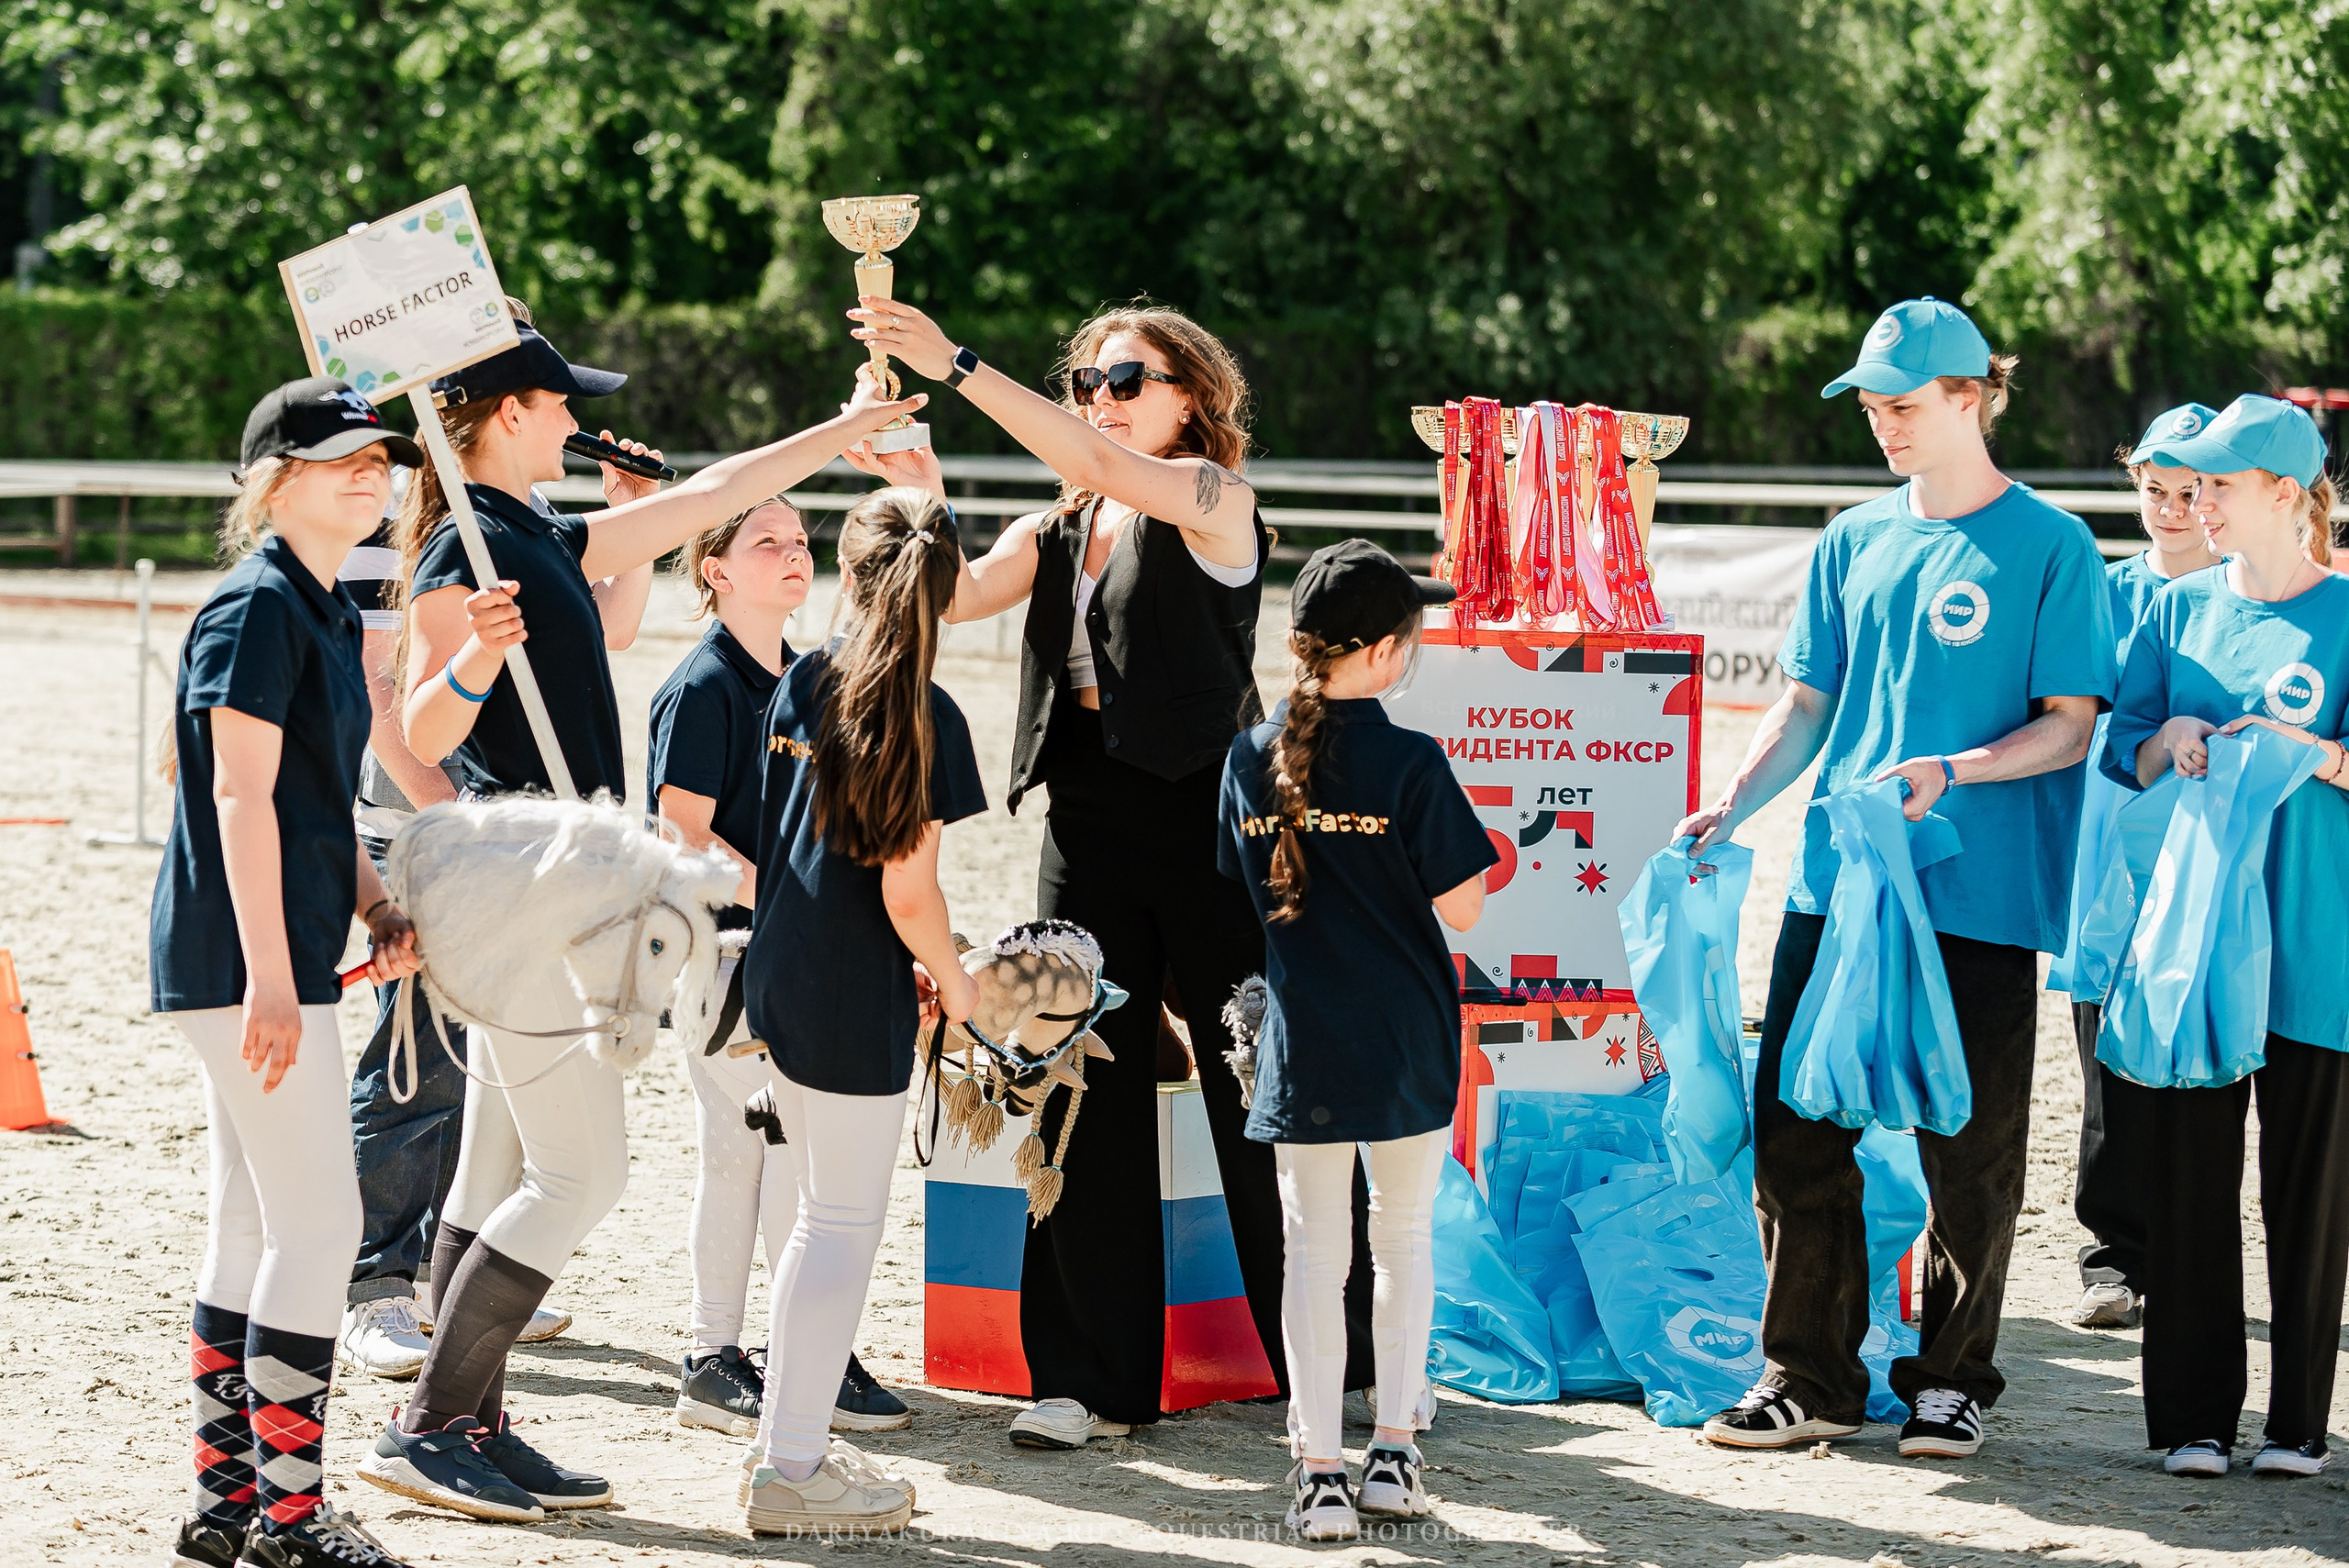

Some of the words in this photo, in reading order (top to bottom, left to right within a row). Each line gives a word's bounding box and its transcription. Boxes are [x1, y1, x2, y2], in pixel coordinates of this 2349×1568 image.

[334, 303, 397, 343] HORSE
[401, 271, 473, 314] FACTOR
[1563, 537, 1571, 556] СПОРТ
[1705, 651, 1785, 685] ОРУ
[2280, 684, 2310, 699] МИР
[1467, 706, 1575, 730] КУБОК
[1586, 740, 1675, 762] ФКСР
[1537, 786, 1594, 806] лет
[1695, 1332, 1748, 1347] МИР
